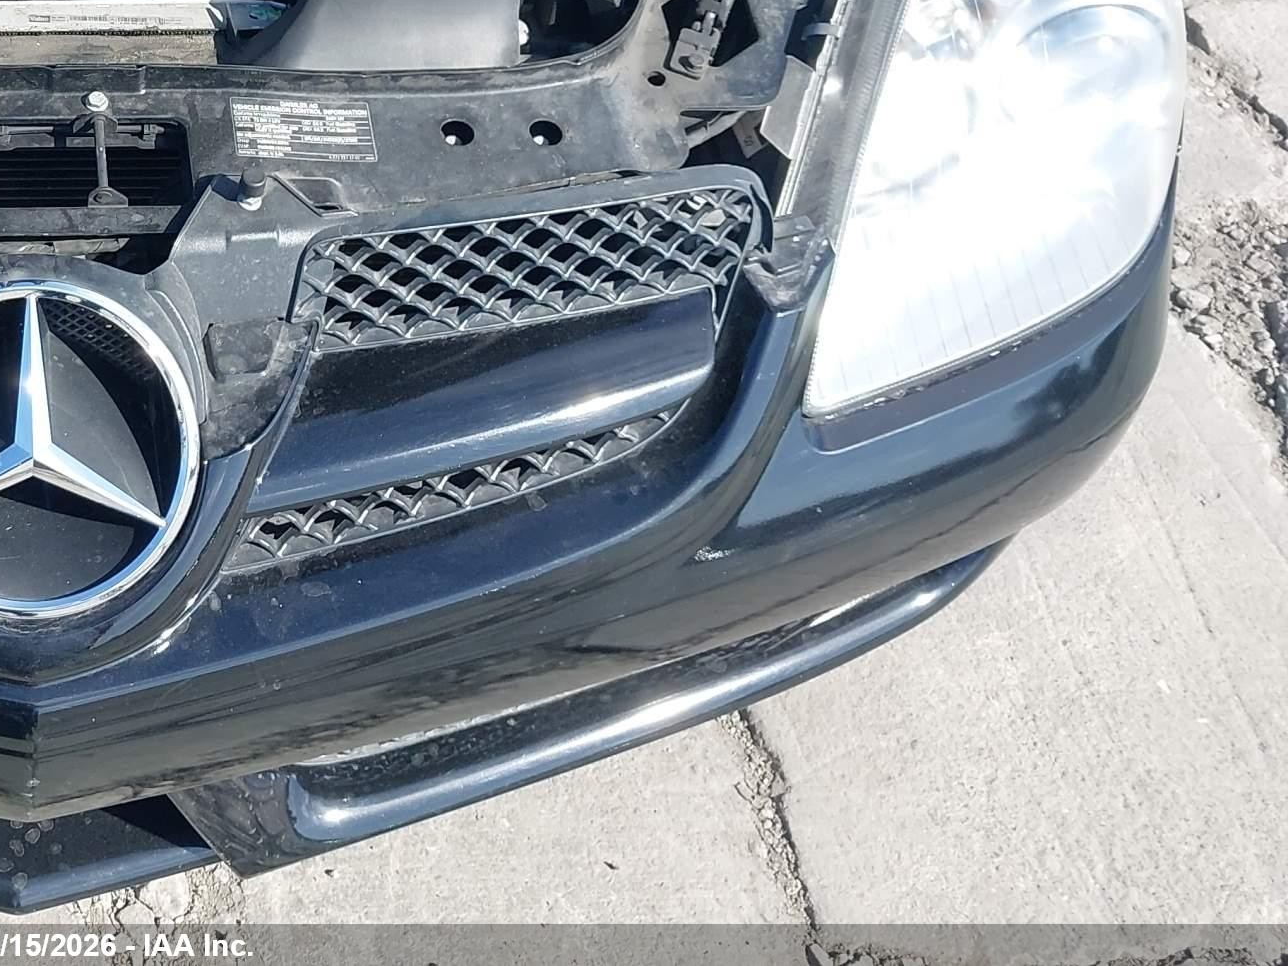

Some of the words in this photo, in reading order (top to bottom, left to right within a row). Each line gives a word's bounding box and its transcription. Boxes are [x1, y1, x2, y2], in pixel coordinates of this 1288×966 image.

[233, 103, 259, 111] VEHICLE
[260, 105, 291, 113] EMISSION
[292, 107, 322, 115] CONTROL
[323, 108, 368, 116] INFORMATION
